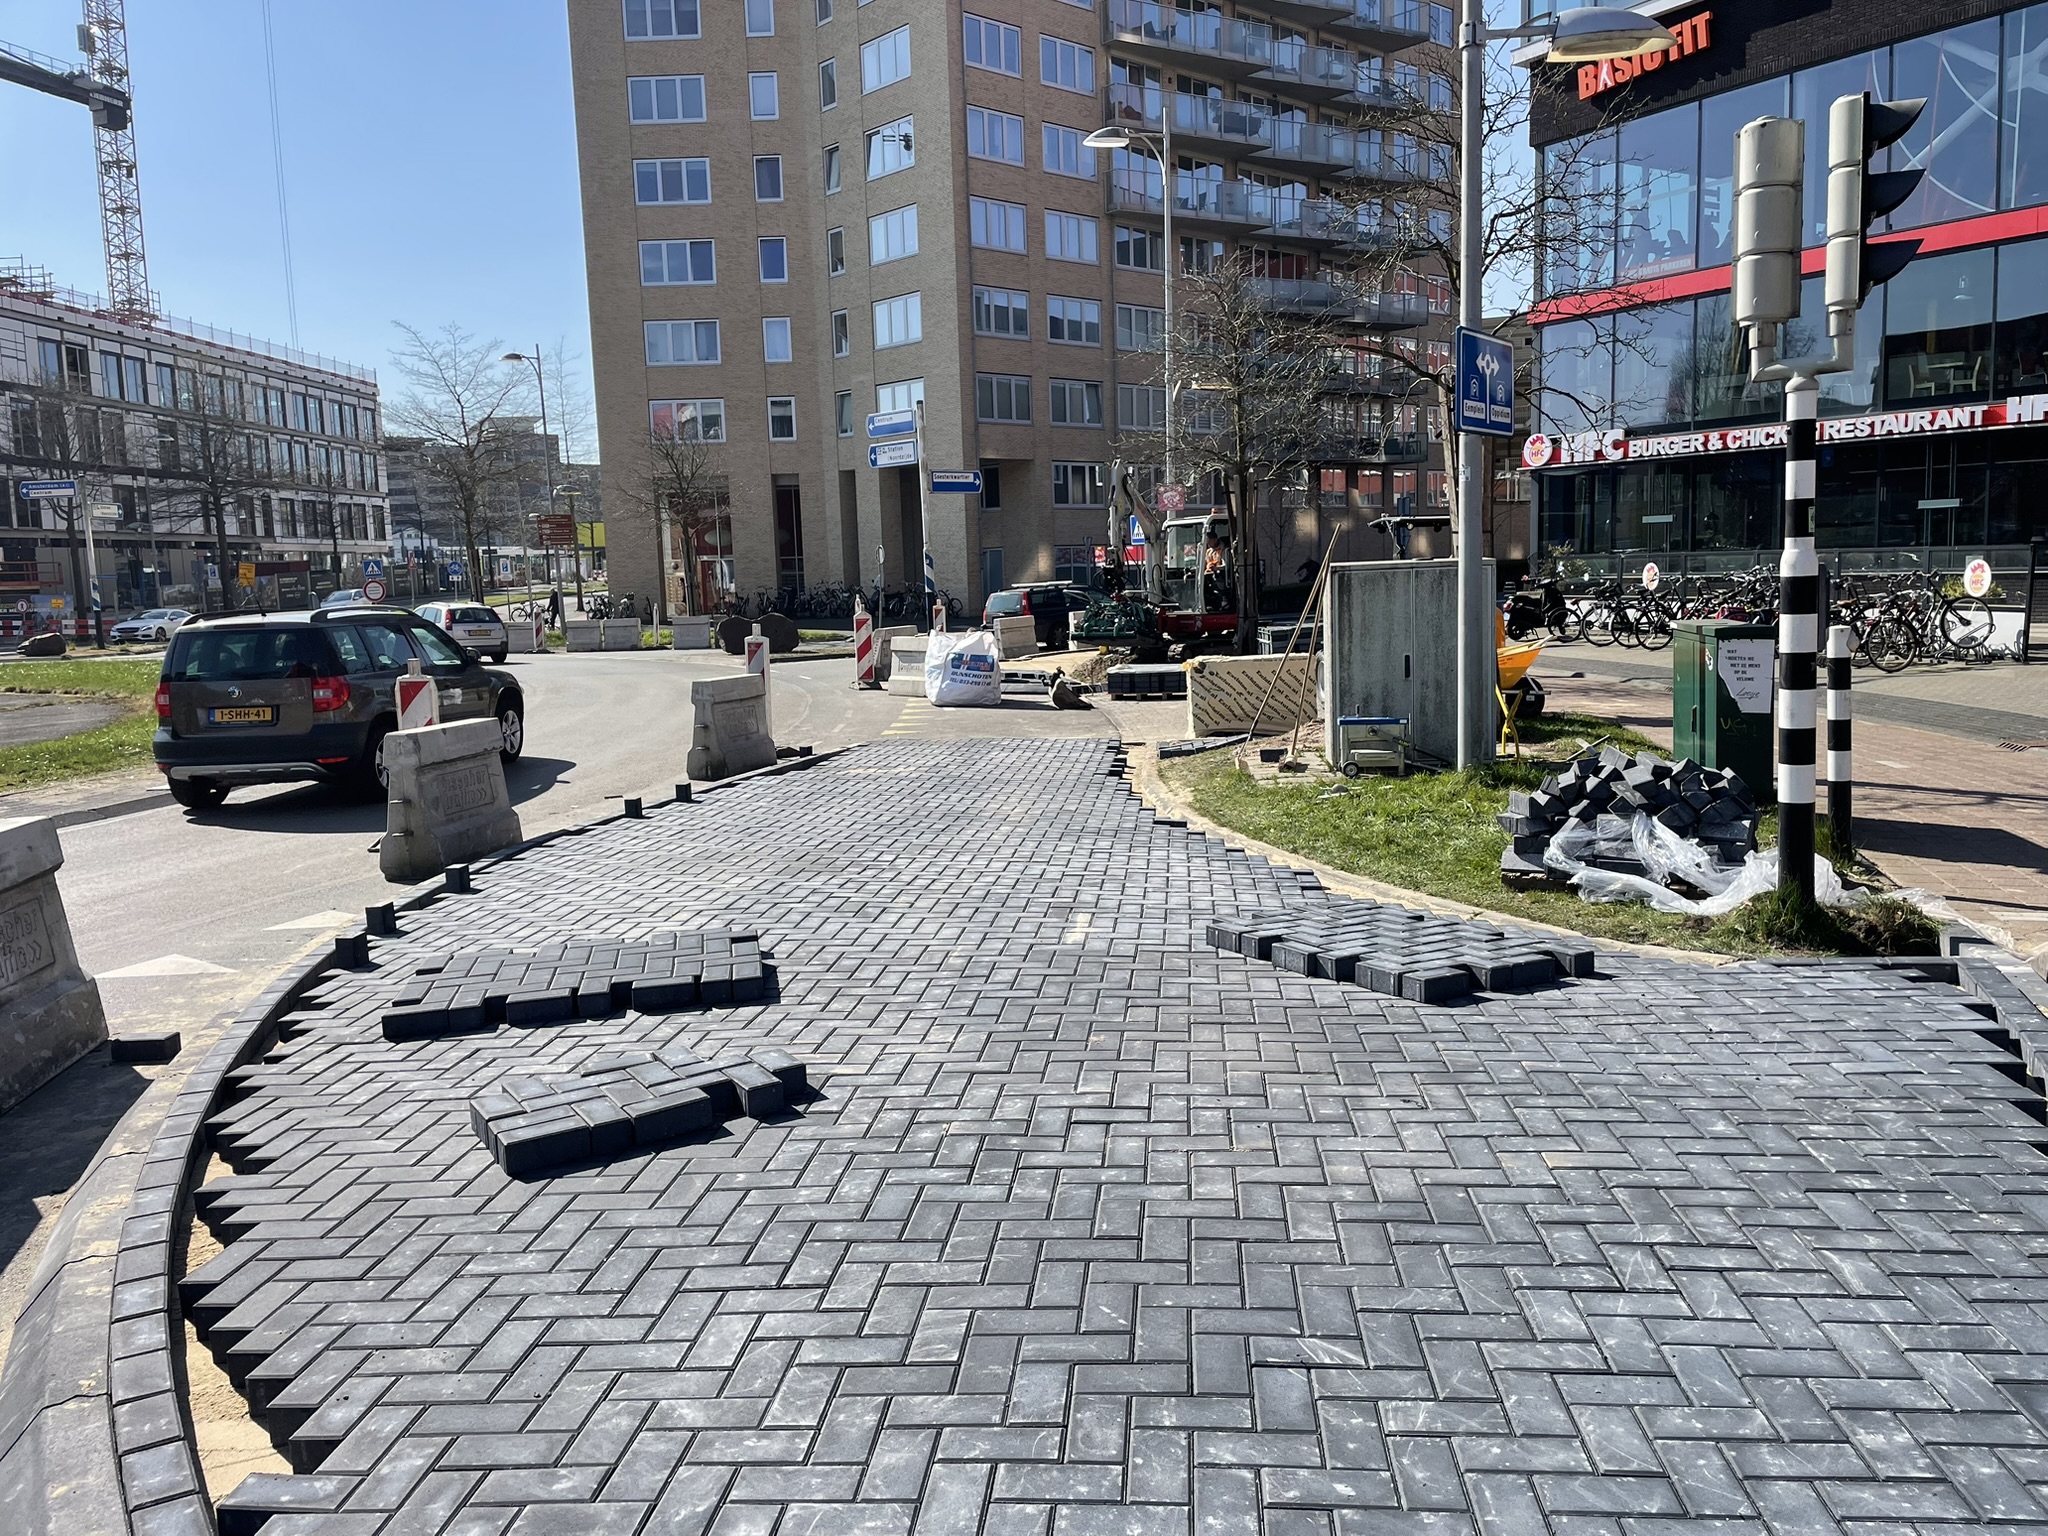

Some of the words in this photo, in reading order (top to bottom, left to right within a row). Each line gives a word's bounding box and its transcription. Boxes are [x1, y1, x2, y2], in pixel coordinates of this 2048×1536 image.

[1560, 429, 1625, 464] HFC
[1628, 434, 1706, 458] BURGER
[1708, 431, 1724, 450] &
[1727, 422, 1821, 449] CHICK
[1823, 405, 1988, 440] RESTAURANT
[1531, 450, 1545, 458] HFC
[220, 709, 267, 720] 1-SHH-41
